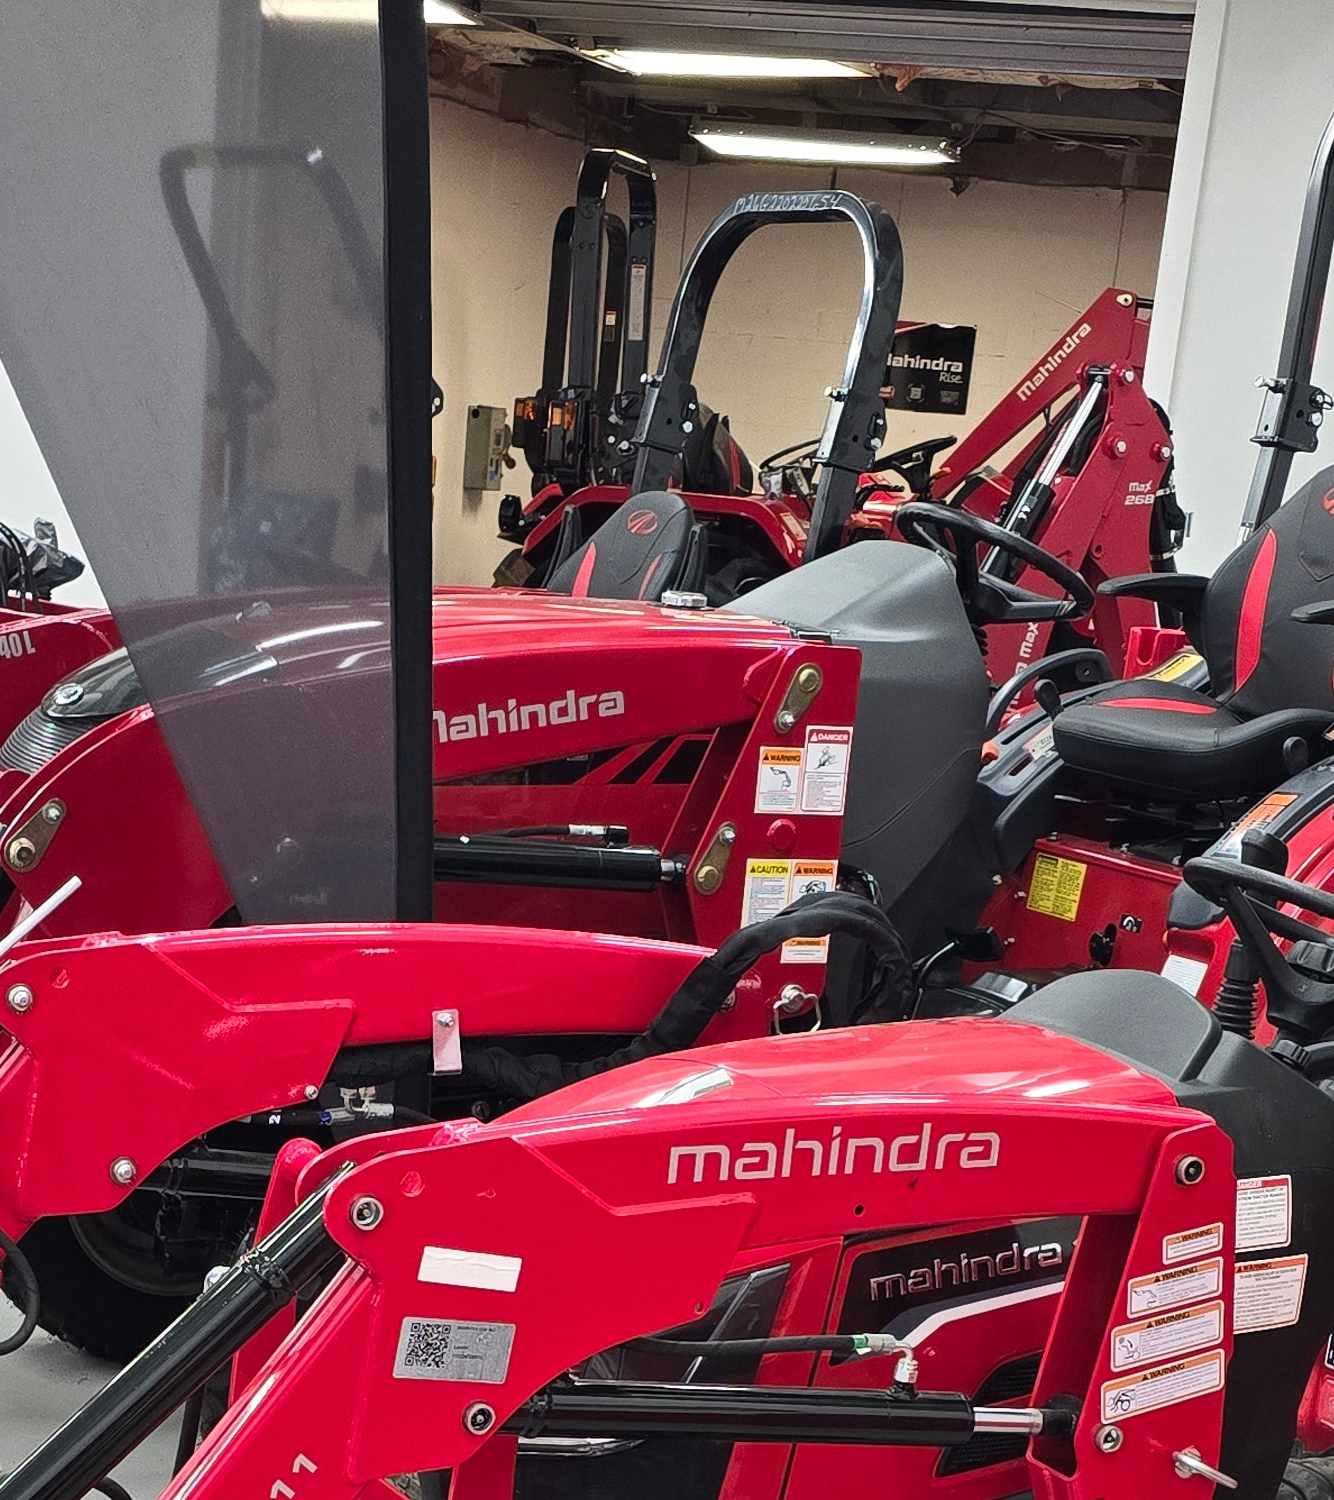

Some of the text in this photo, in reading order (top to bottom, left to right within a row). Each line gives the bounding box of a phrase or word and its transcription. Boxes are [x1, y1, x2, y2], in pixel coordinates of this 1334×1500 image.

[888, 353, 963, 372] ahindra
[818, 733, 848, 742] DANGER
[770, 754, 800, 762] WARNING
[756, 865, 789, 874] CAUTION
[803, 867, 833, 875] WARNING
[668, 1123, 1001, 1185] mahindra
[1182, 1228, 1213, 1241] WARNING
[870, 1242, 1063, 1301] mahindra
[1162, 1265, 1198, 1281] WARNING
[1149, 1363, 1185, 1379] WARNING
